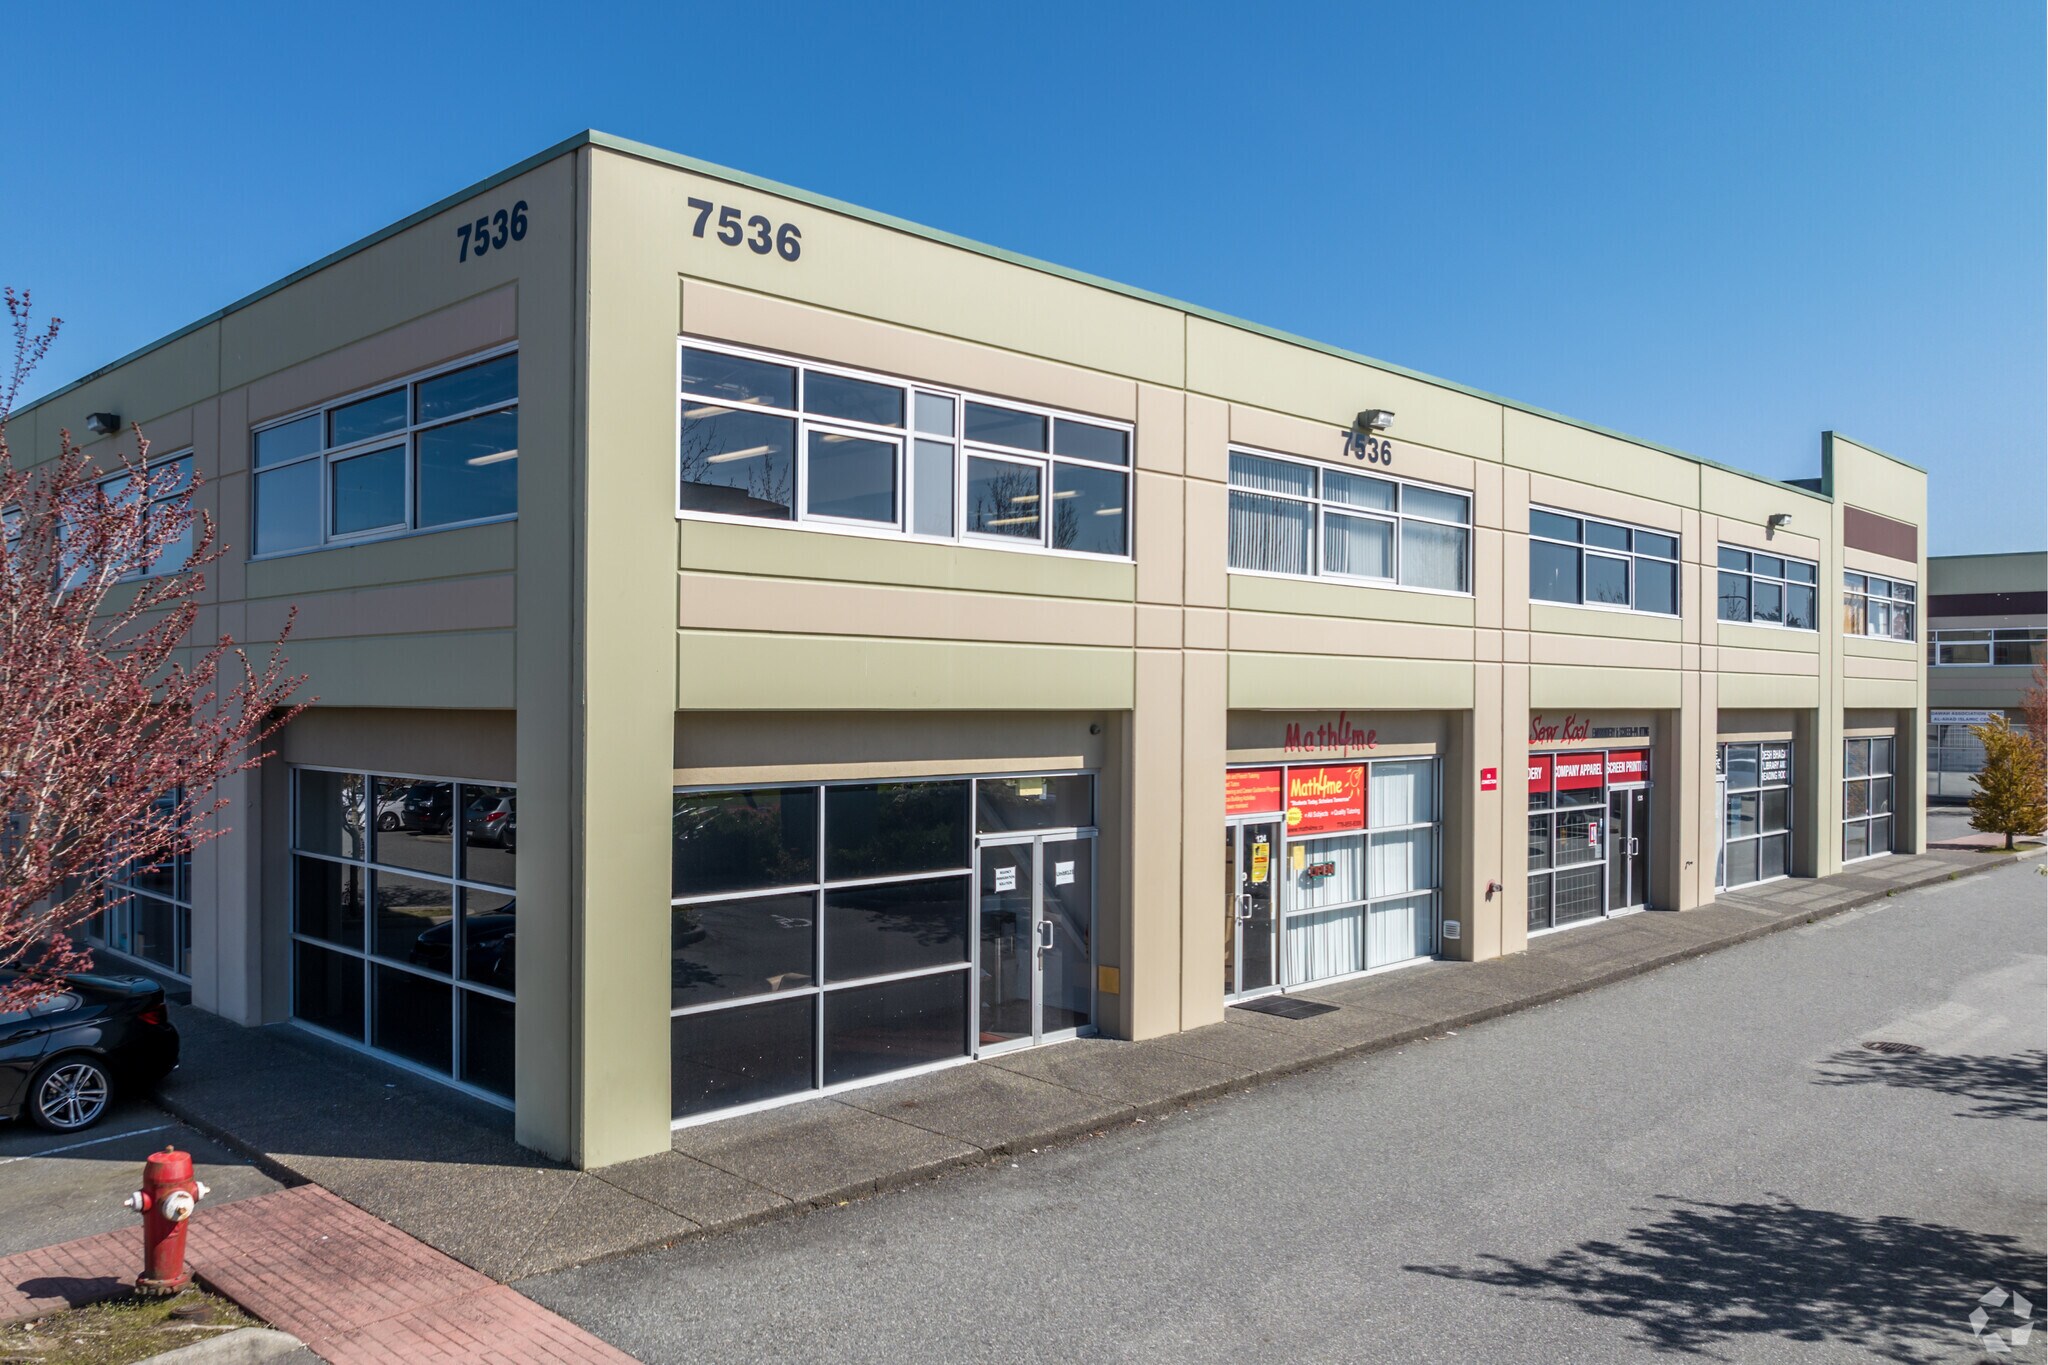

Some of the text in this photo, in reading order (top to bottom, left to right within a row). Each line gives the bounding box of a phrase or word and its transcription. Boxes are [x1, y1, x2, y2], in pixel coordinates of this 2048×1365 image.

[457, 200, 529, 263] 7536
[688, 197, 802, 263] 7536
[1341, 430, 1392, 466] 7536
[1284, 711, 1378, 757] Math4me
[1529, 714, 1590, 744] Sew Kool
[1580, 763, 1603, 776] APPAREL
[1607, 760, 1648, 773] SCREEN PRINTING
[1290, 768, 1343, 798] Math4me
[1310, 863, 1334, 877] OPEN
